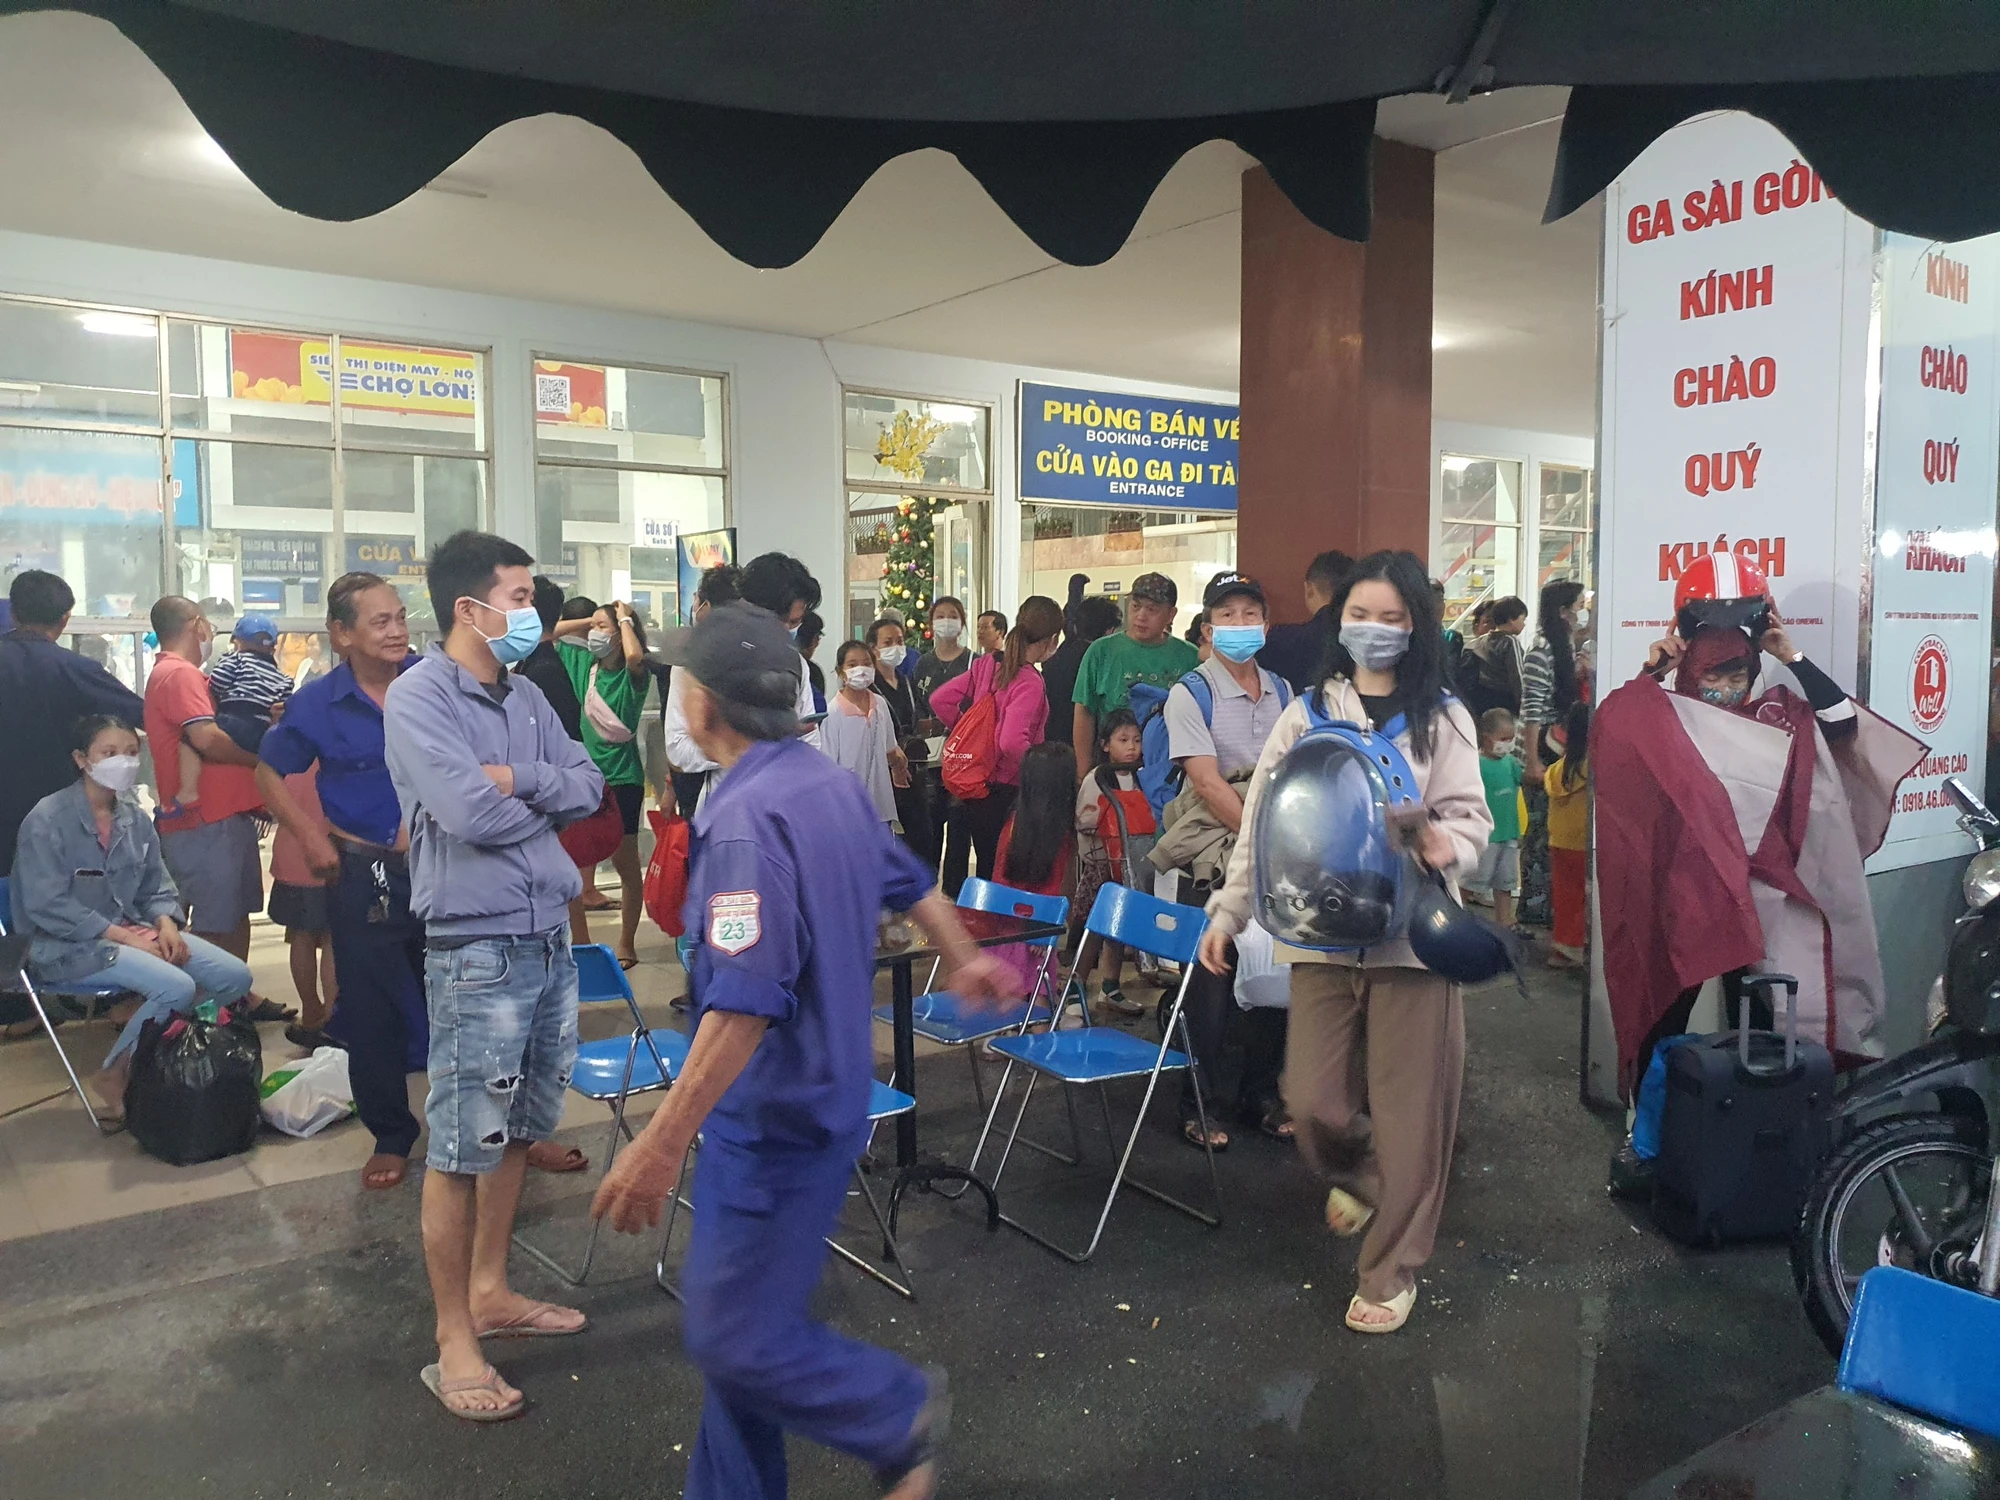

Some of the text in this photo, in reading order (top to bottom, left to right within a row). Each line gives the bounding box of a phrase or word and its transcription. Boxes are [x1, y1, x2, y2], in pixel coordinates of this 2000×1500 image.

[1627, 199, 1675, 244] GA
[1682, 179, 1743, 232] SÀI
[1679, 264, 1774, 321] KÍNH
[1926, 249, 1969, 305] KÍNH
[361, 374, 415, 398] CHỢ
[1673, 354, 1777, 408] CHÀO
[1920, 344, 1968, 395] CHÀO
[1043, 398, 1142, 431] PHÒNG
[1150, 409, 1205, 438] BÁN
[1086, 429, 1152, 447] BOOKING
[1160, 436, 1209, 452] OFFICE
[1036, 443, 1239, 486] CỬA VÀO GA ĐI TÀ
[1685, 442, 1762, 497] QUÝ
[1923, 437, 1960, 485] QUÝ
[1109, 481, 1185, 498] ENTRANCE
[1951, 751, 1968, 774] CÁO
[721, 922, 745, 940] 23
